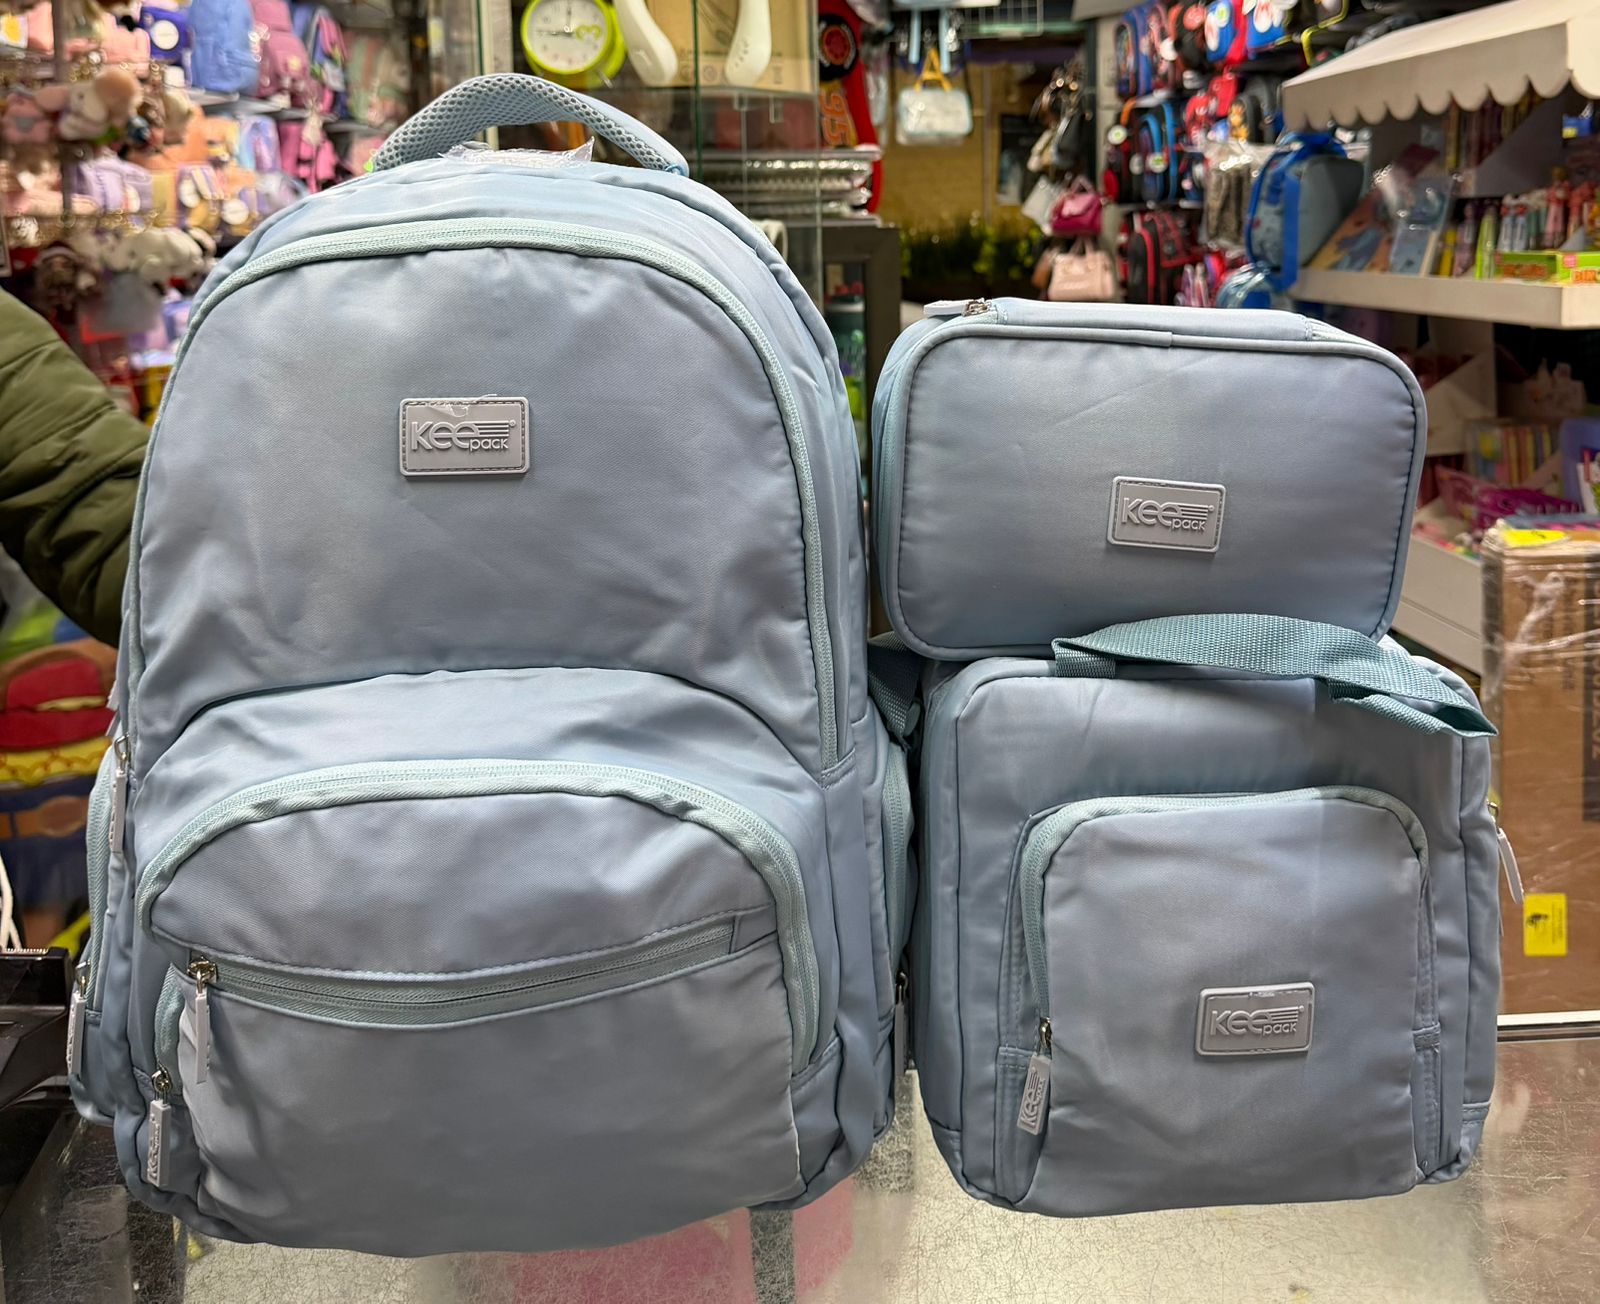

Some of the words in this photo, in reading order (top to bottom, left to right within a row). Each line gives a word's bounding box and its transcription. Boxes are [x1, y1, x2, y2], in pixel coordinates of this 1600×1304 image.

[469, 438, 509, 452] pack
[1171, 518, 1206, 532] pack
[1262, 1022, 1297, 1036] pack
